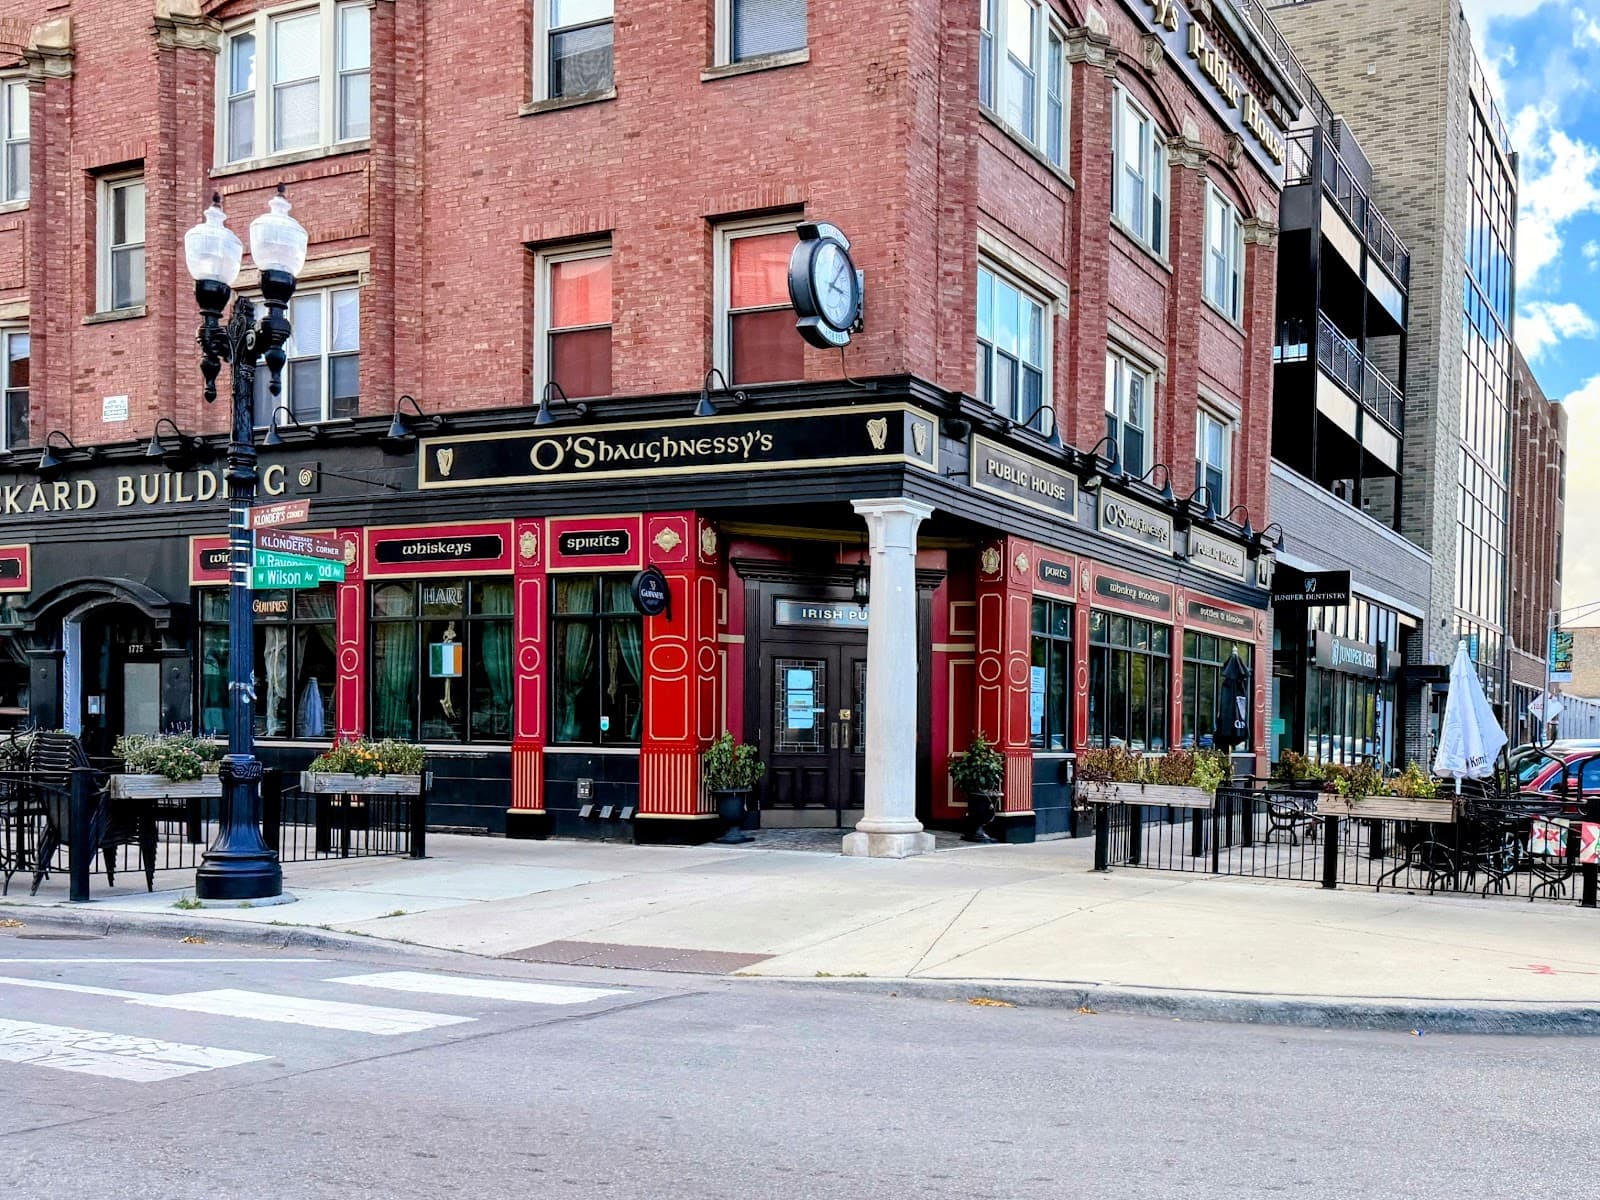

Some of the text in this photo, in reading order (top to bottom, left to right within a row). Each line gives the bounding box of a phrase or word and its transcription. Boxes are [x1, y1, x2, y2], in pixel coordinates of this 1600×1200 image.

[1188, 21, 1240, 109] Public
[1243, 93, 1286, 165] House
[530, 430, 773, 471] O'Shaughnessy's
[987, 459, 1065, 501] PUBLIC HOUSE
[0, 465, 285, 514] KARD BUILDIG
[254, 510, 286, 526] KLONDER'S
[261, 536, 339, 555] KLONDER'S CORNER
[402, 542, 472, 556] whiskeys
[567, 535, 620, 550] spirits
[258, 570, 313, 585] W Wilson Av
[1274, 592, 1346, 601] JUNIPER DENTISTRY
[802, 608, 868, 620] IRISH PU
